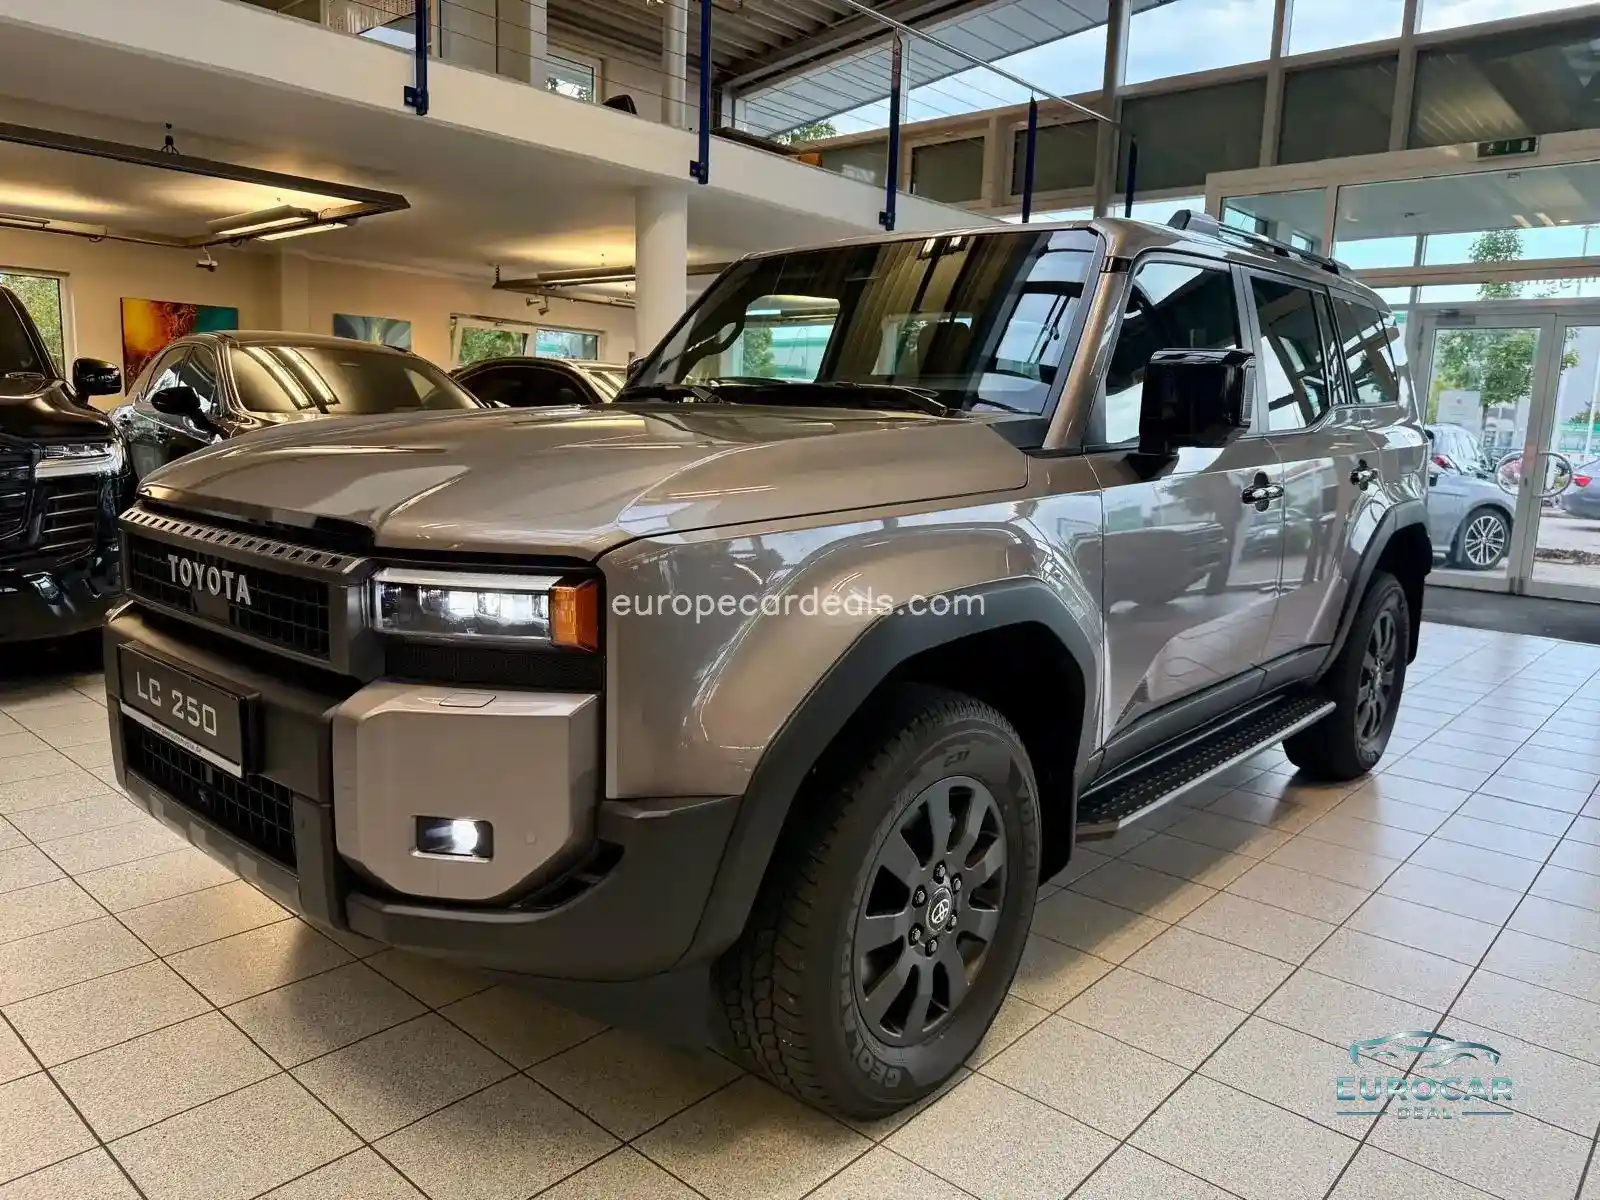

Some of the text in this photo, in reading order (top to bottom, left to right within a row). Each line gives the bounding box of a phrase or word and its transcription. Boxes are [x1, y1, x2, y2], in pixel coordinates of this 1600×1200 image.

[168, 554, 251, 605] TOYOTA
[136, 671, 162, 707] LC
[171, 689, 217, 736] 250
